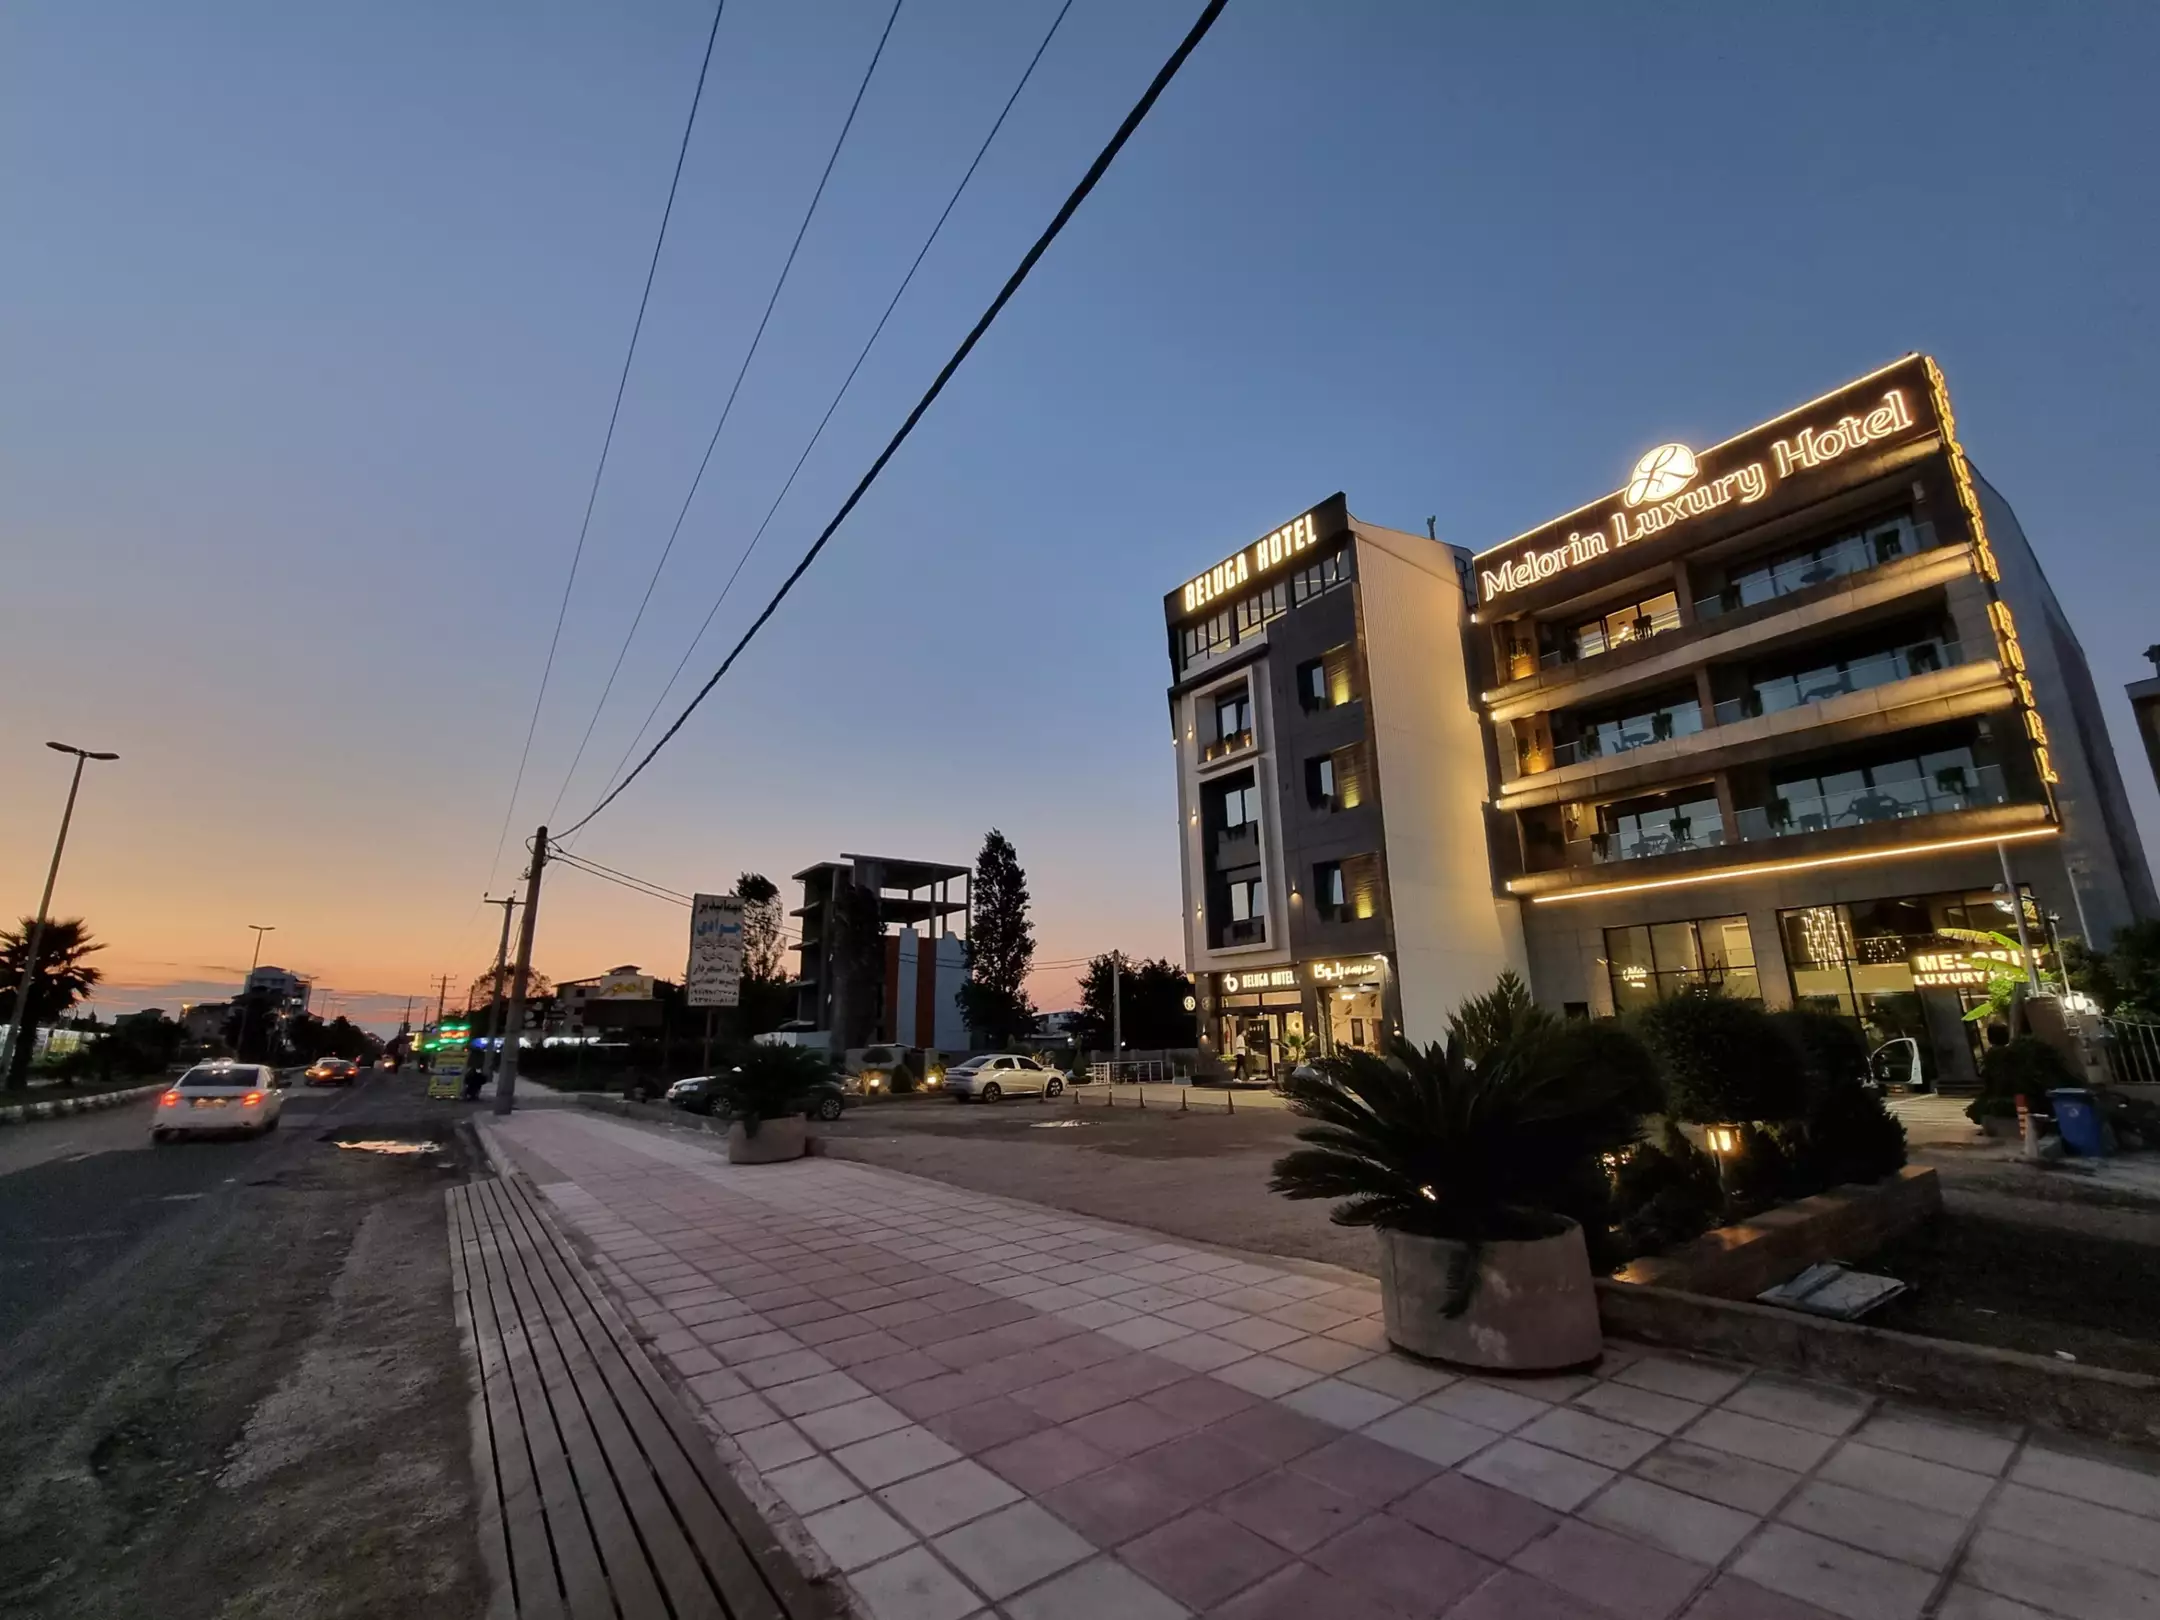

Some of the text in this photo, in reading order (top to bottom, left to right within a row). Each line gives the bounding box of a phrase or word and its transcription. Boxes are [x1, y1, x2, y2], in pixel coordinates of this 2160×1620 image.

[1481, 390, 1913, 602] Melorin Luxury Hotel
[1184, 513, 1317, 612] BELUGA HOTEL
[1914, 971, 1985, 985] LUXURY
